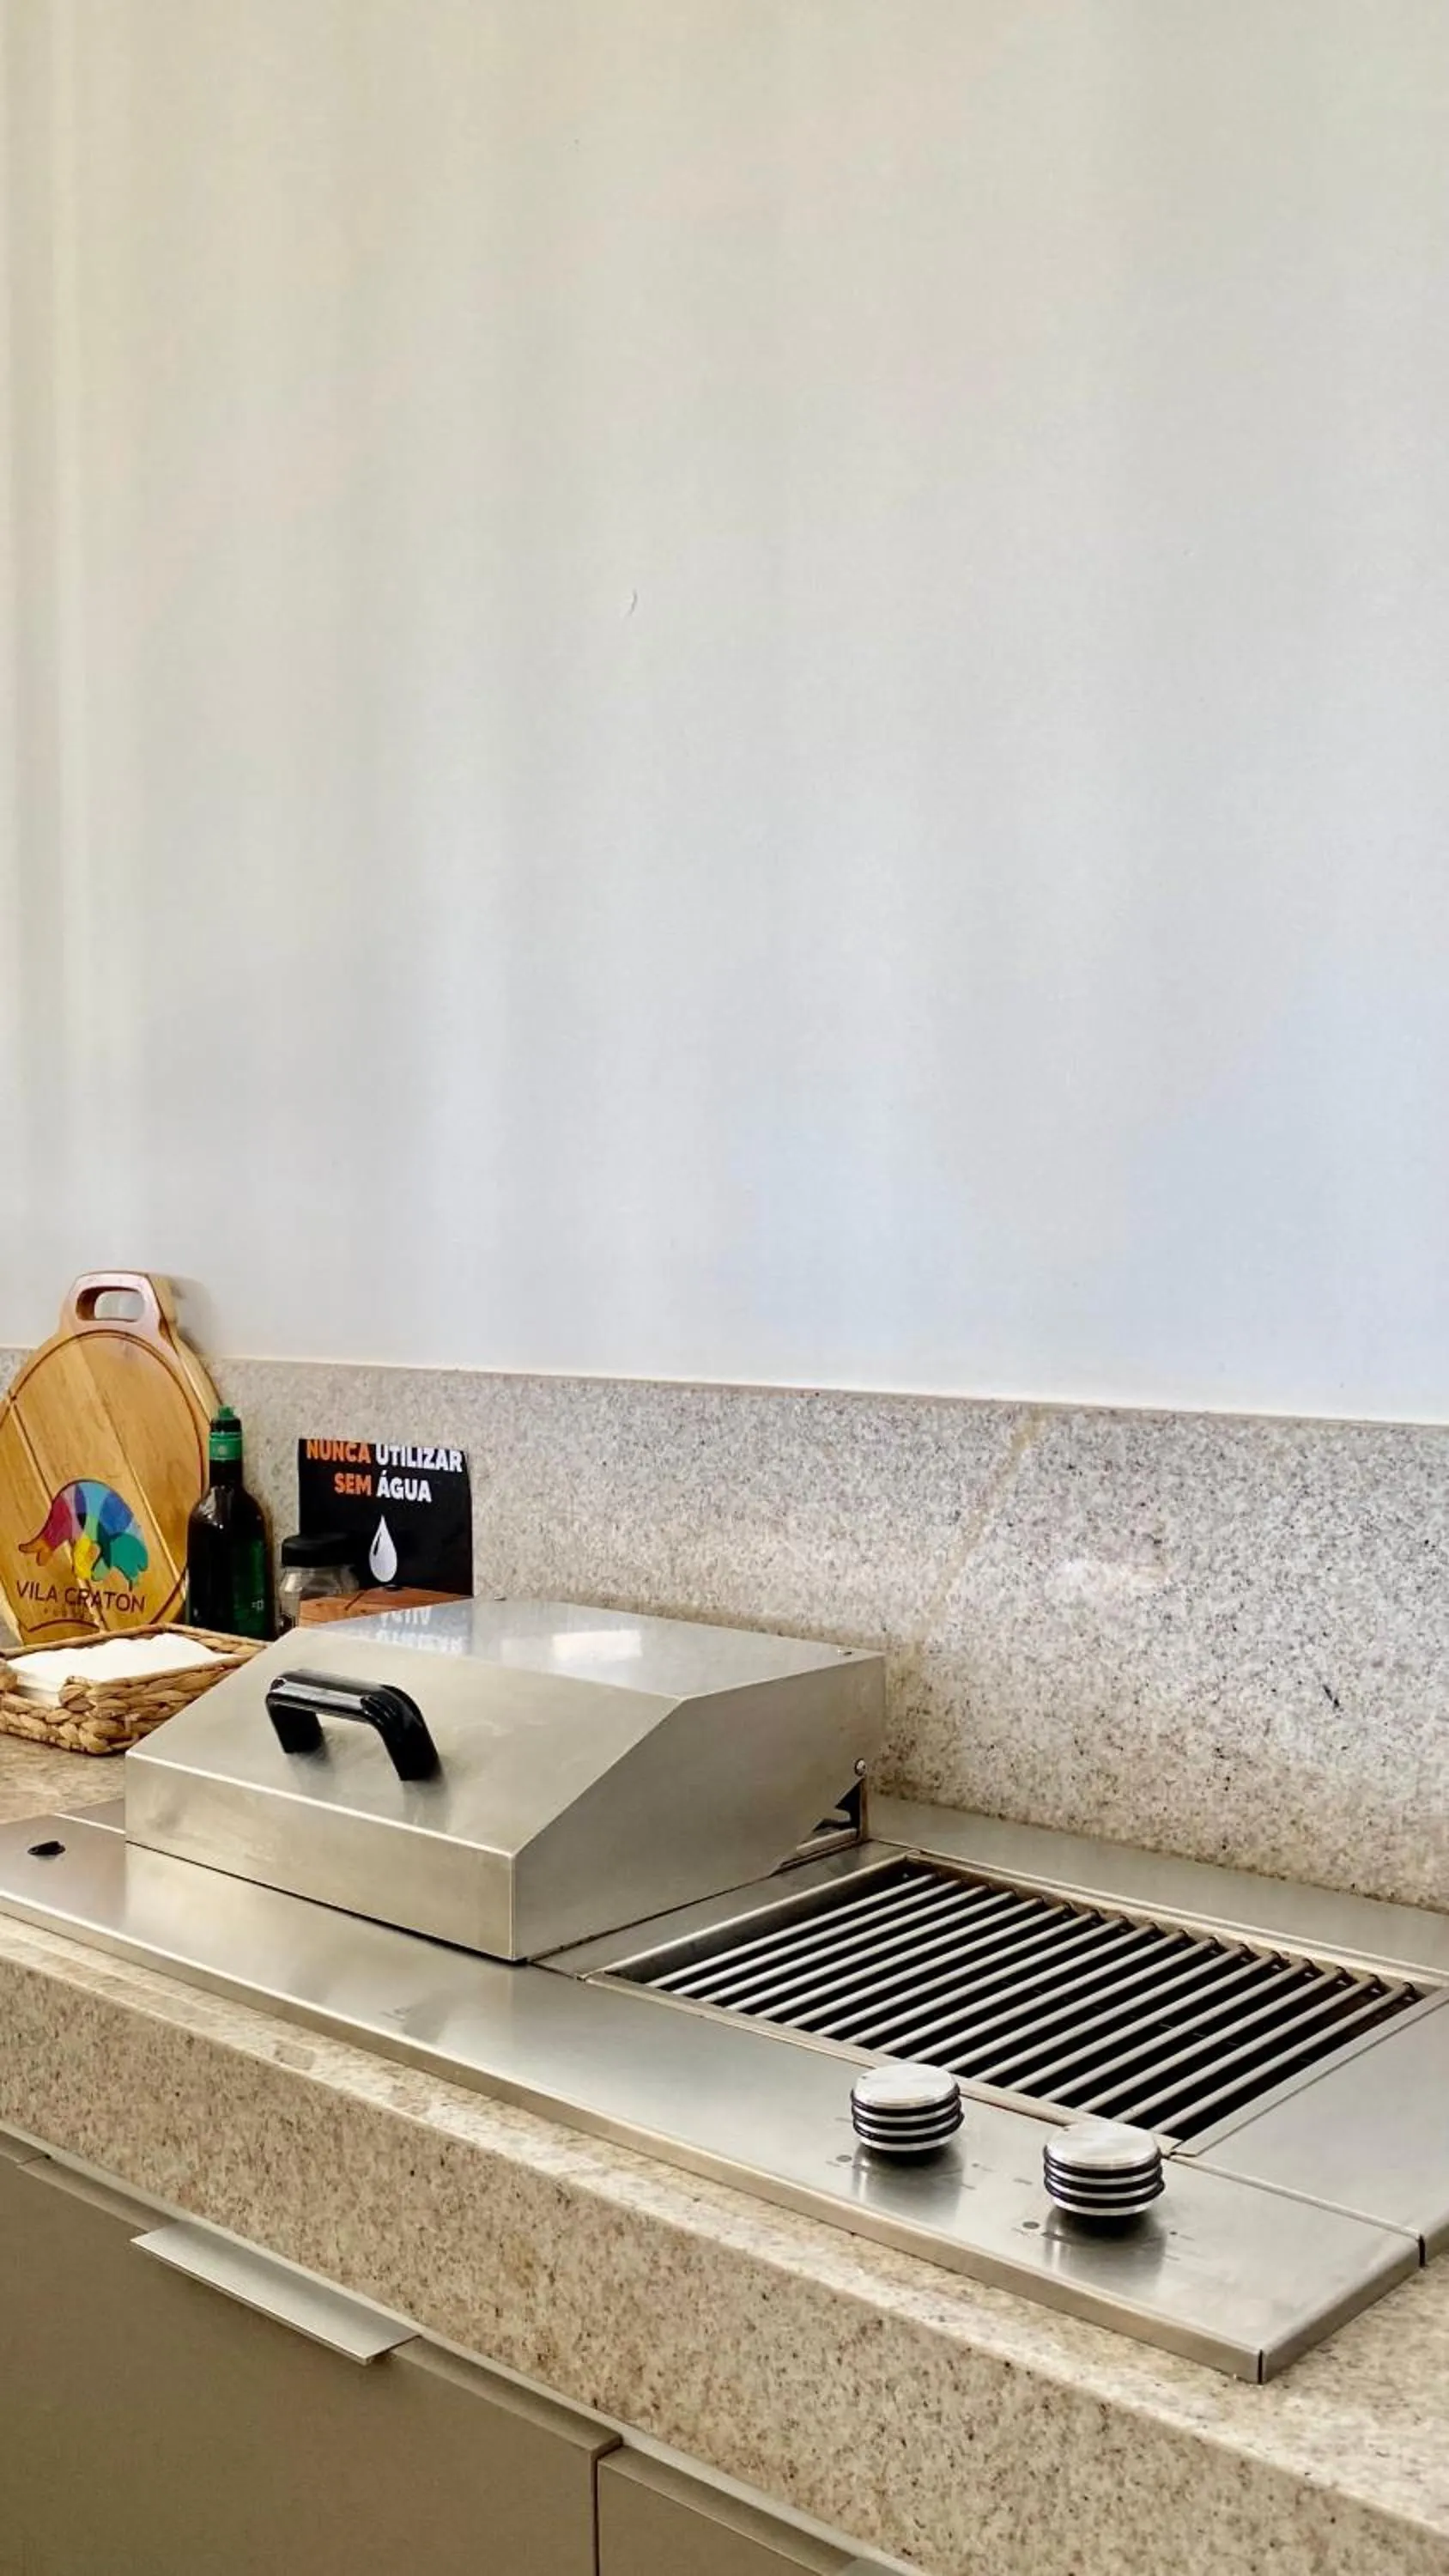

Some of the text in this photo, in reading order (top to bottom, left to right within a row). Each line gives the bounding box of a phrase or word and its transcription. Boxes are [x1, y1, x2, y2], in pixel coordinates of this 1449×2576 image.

[306, 1439, 463, 1473] NUNCA UTILIZAR
[334, 1469, 432, 1503] SEM ÁGUA
[16, 1580, 58, 1603] VILA
[64, 1588, 145, 1613] CRATON
